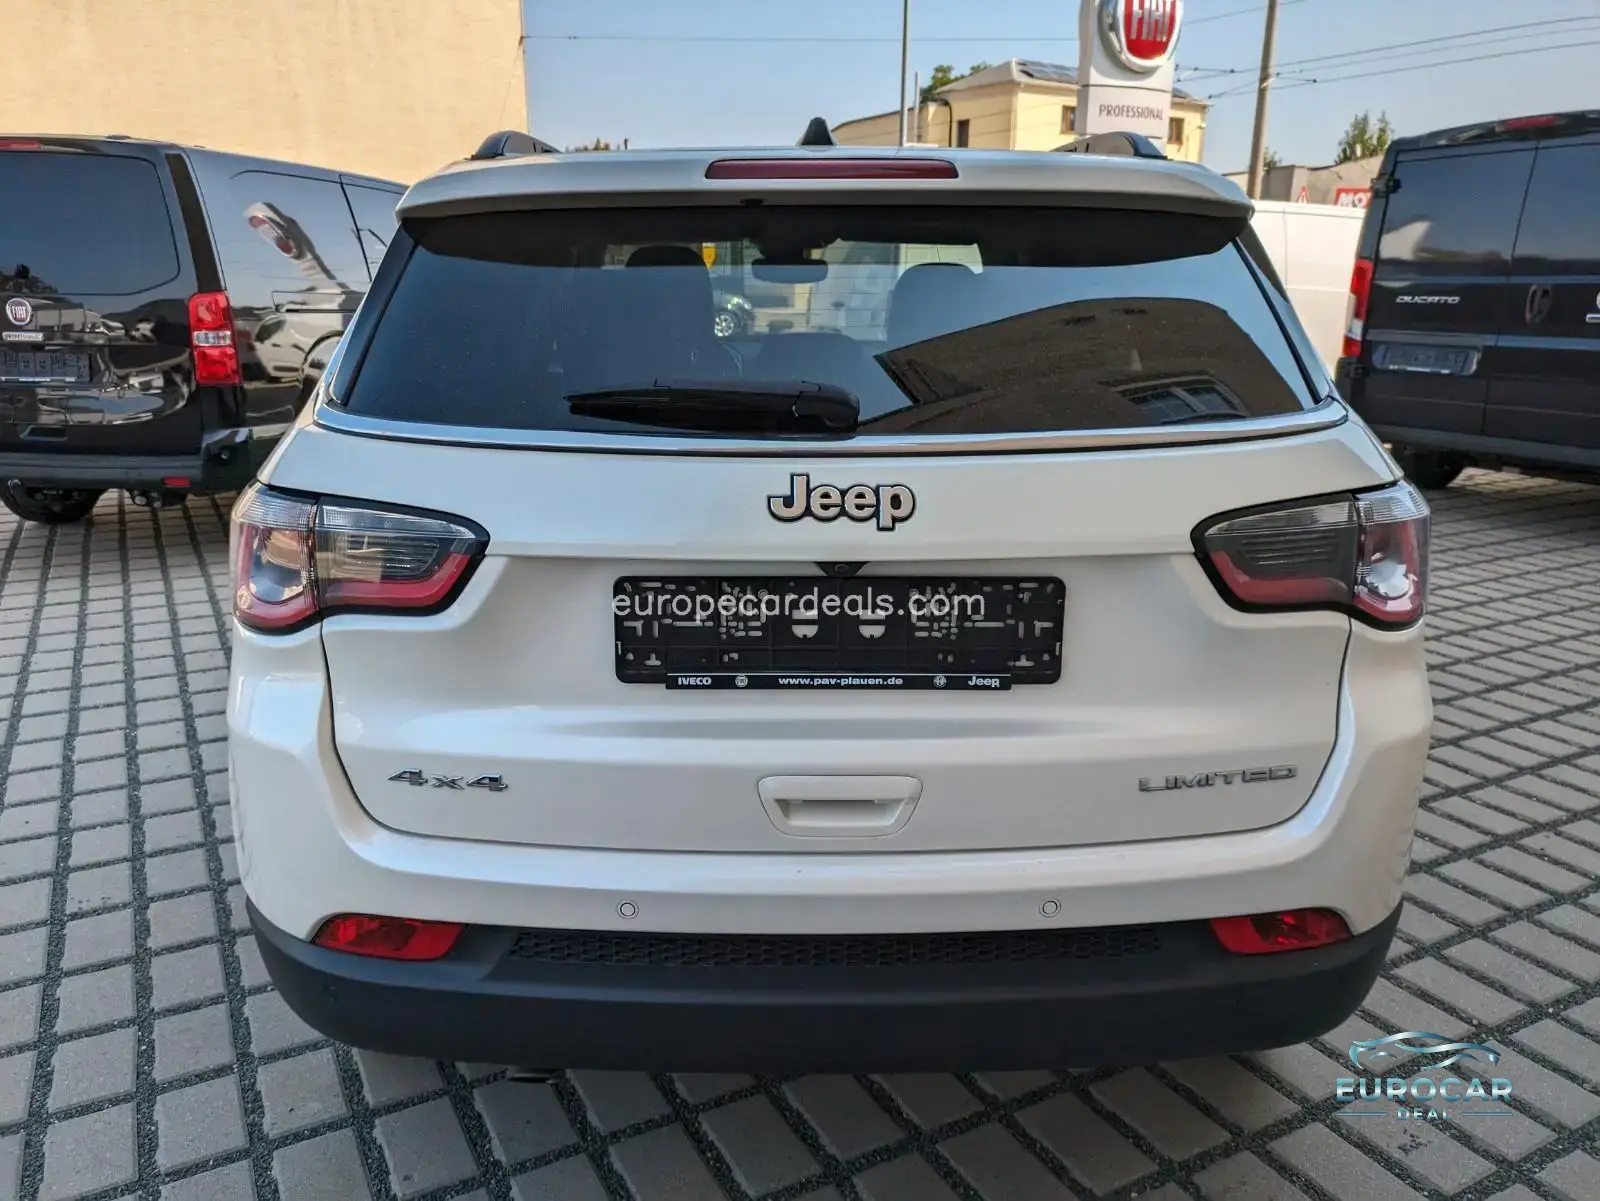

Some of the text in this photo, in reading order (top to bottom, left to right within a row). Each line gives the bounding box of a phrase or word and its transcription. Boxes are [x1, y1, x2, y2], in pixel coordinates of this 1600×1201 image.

[1130, 0, 1173, 42] FIAT
[1099, 103, 1164, 121] PROFESSIONAL
[1395, 295, 1461, 304] DUCATO
[11, 305, 27, 319] FIAT
[767, 473, 916, 531] Jeep
[677, 676, 712, 685] IVECO
[778, 676, 904, 686] www.pav-plauen.de
[968, 676, 1000, 688] Jeep
[1138, 764, 1298, 793] LIMITED
